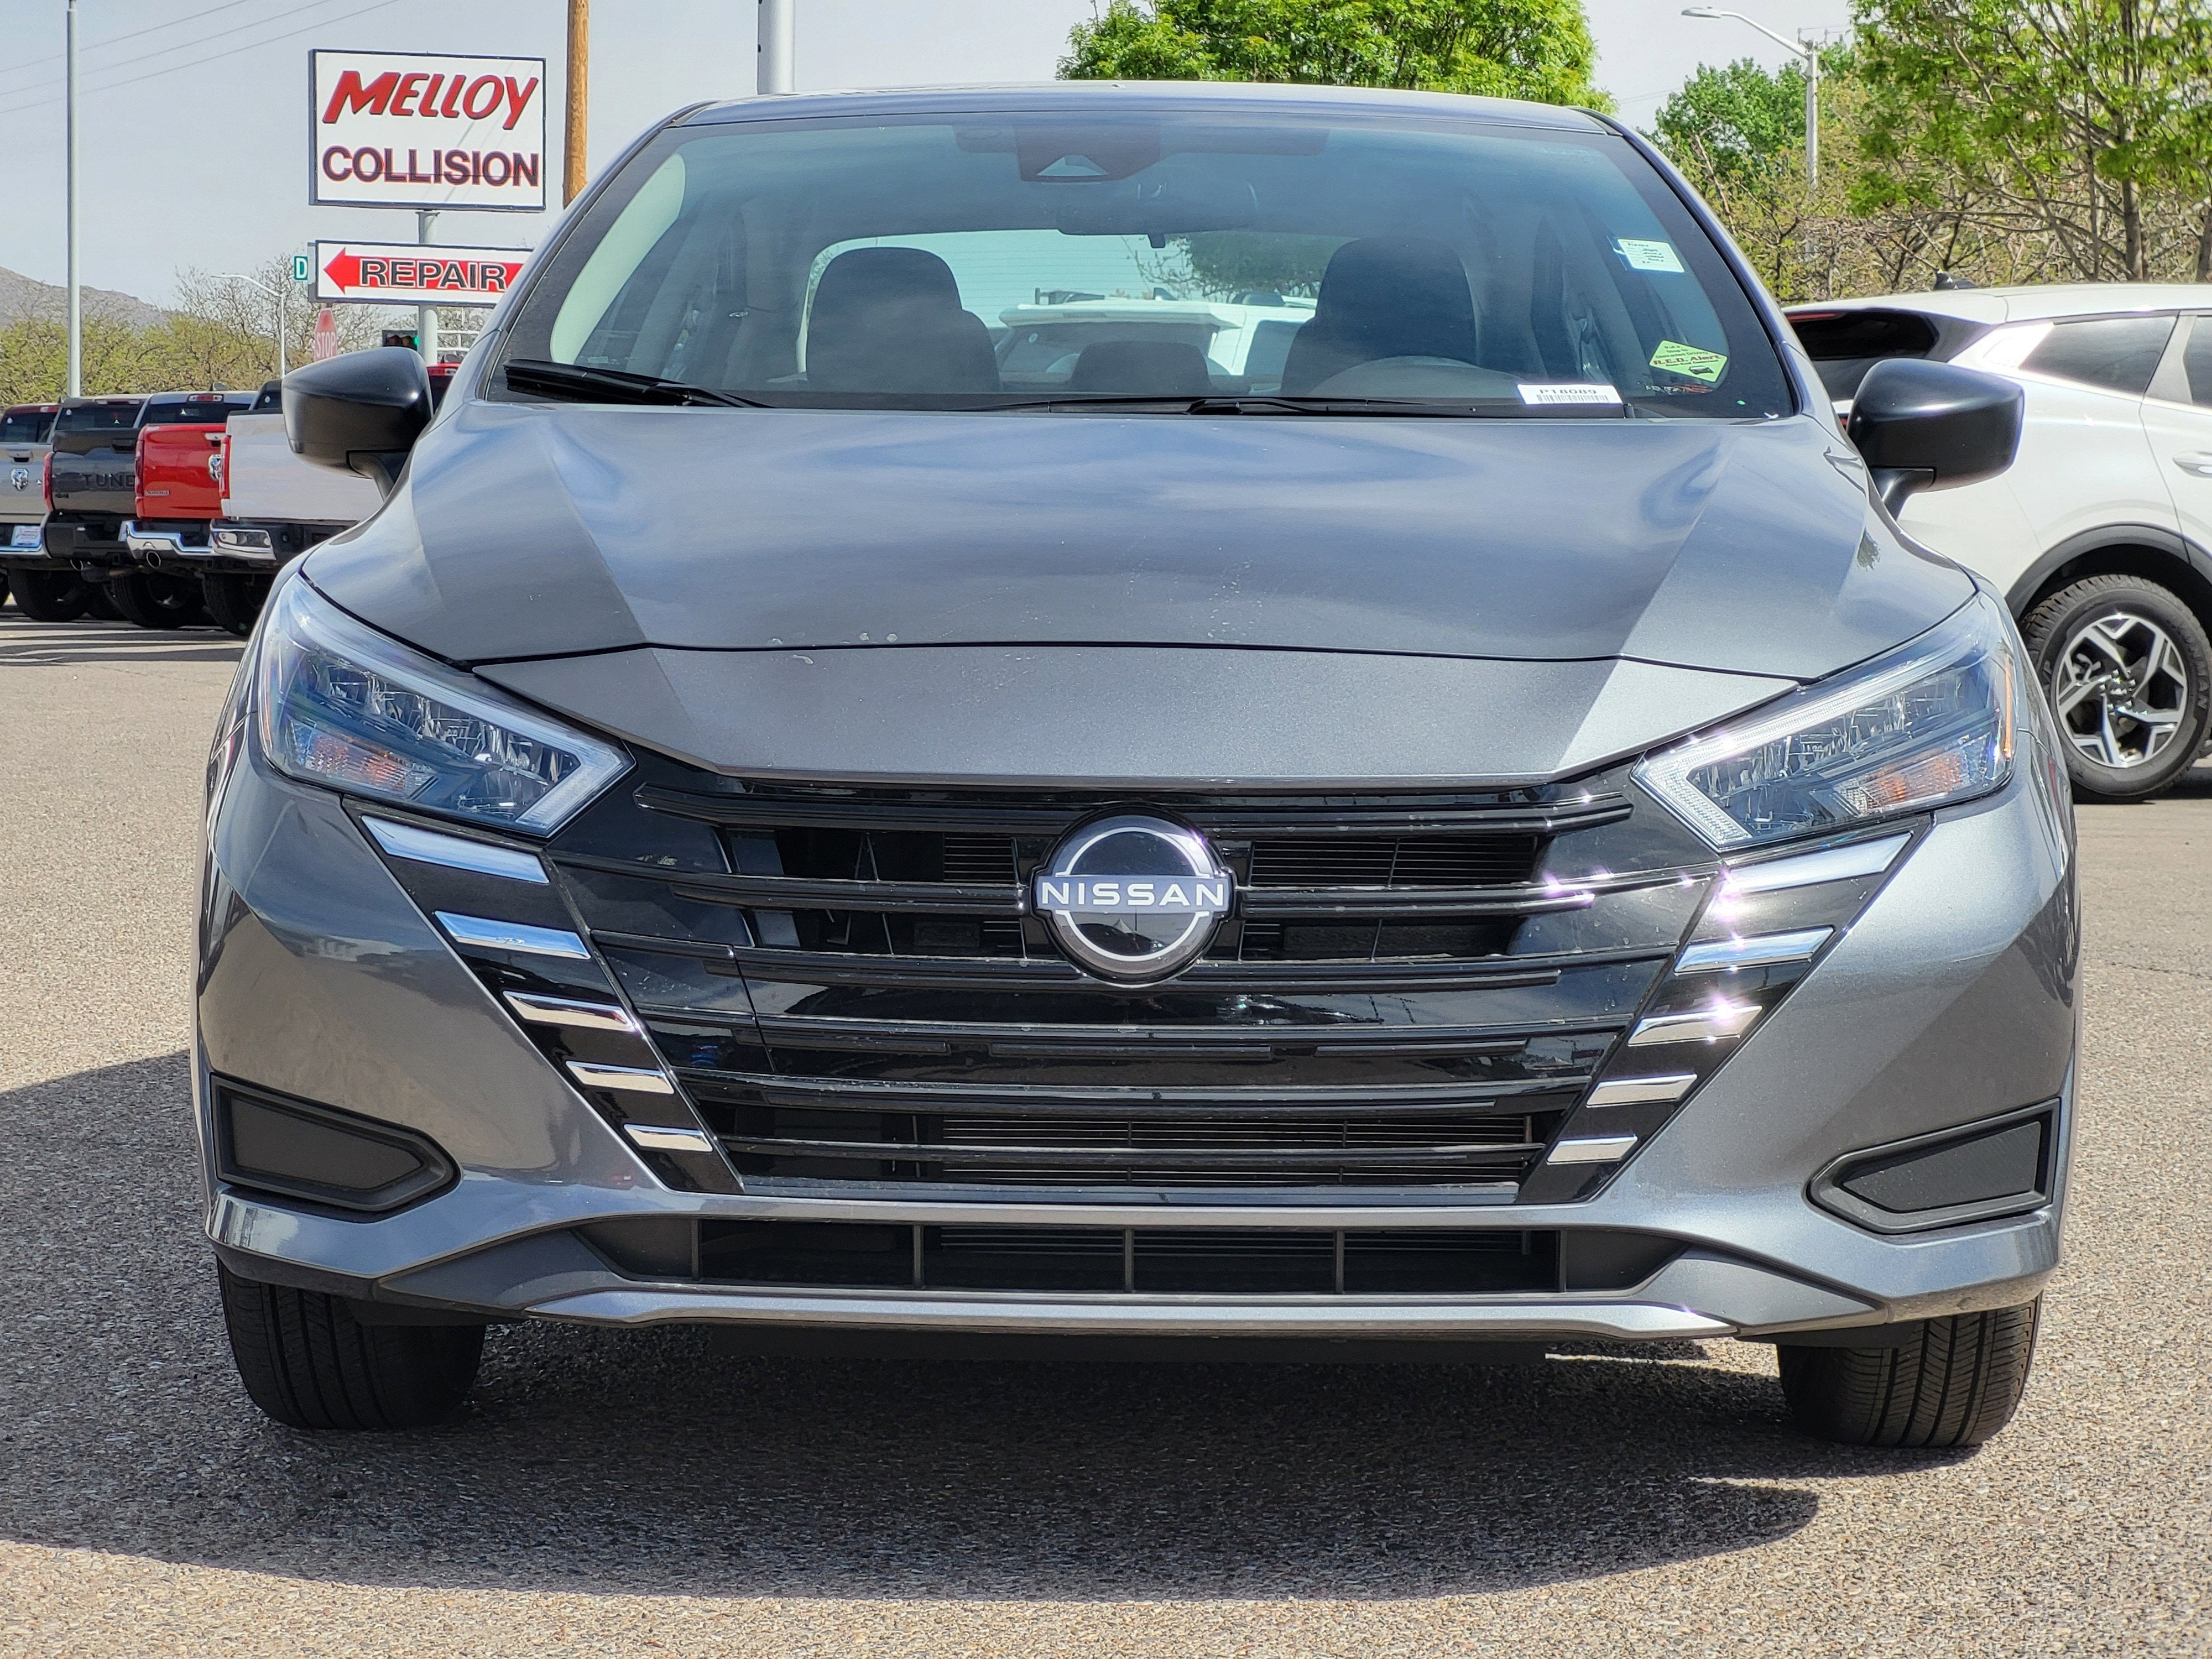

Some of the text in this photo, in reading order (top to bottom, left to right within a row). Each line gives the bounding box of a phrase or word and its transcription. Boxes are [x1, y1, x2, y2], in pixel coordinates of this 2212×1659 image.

[322, 70, 539, 130] MELLOY
[322, 145, 539, 187] COLLISION
[360, 258, 507, 291] REPAIR
[316, 332, 336, 358] STOP
[1042, 882, 1223, 906] NISSAN
